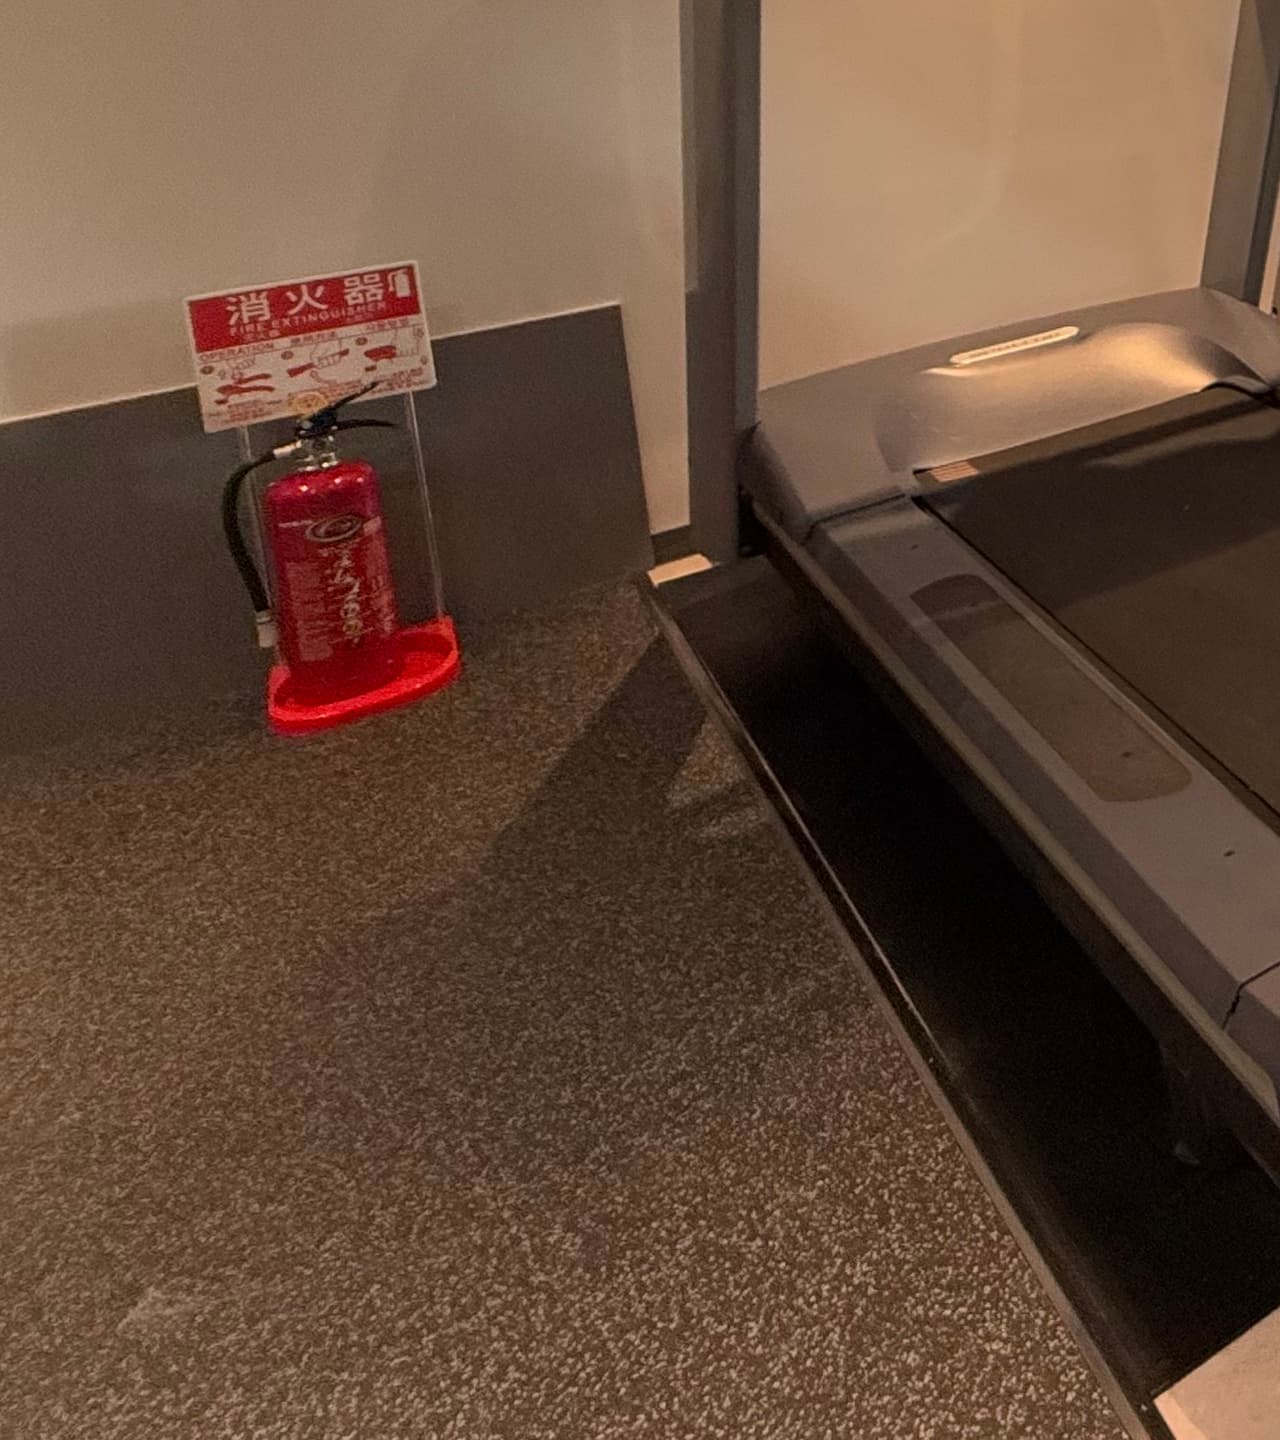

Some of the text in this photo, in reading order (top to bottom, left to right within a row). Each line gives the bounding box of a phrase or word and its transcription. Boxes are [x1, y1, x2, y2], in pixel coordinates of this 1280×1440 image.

[225, 272, 384, 325] 消火器
[229, 322, 267, 337] FIRE
